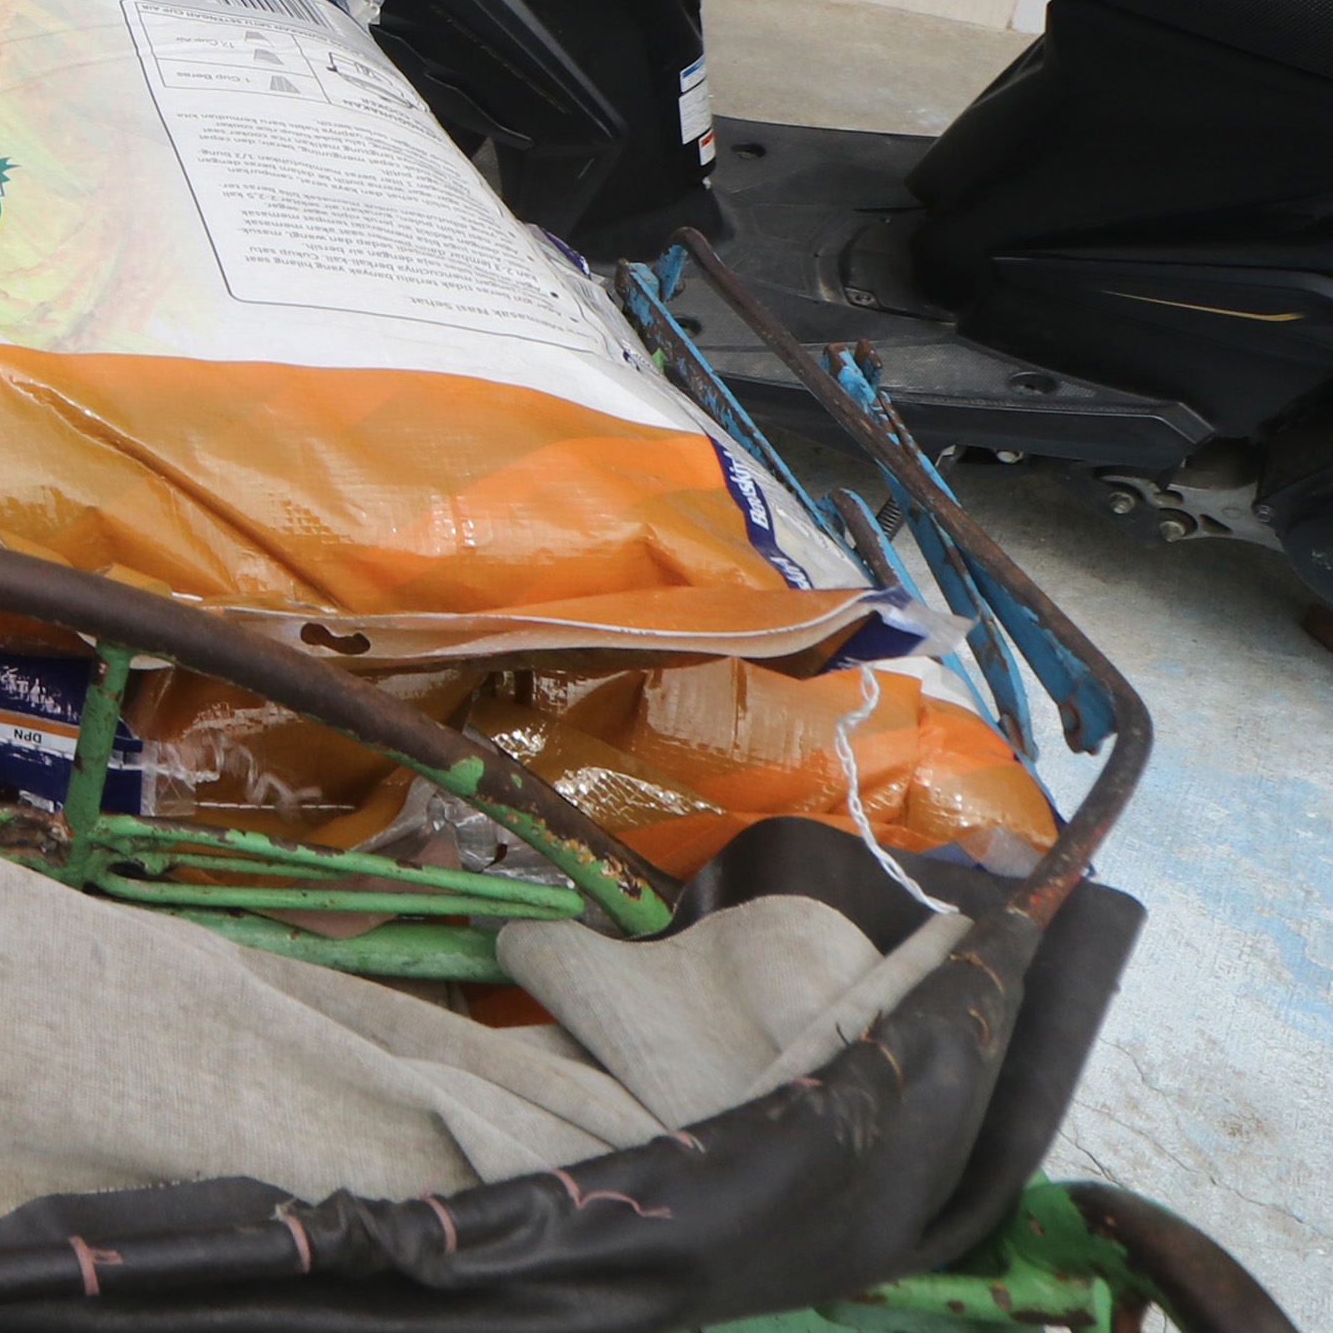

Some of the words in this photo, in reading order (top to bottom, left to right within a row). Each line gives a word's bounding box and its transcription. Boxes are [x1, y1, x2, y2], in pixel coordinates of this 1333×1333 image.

[141, 4, 159, 12] AIR
[162, 7, 183, 15] CUP
[195, 36, 219, 46] Cup
[176, 72, 217, 80] Beras
[221, 73, 241, 82] Cup
[201, 114, 257, 124] kemudian
[260, 119, 286, 128] baru
[216, 122, 254, 130] cooker
[199, 134, 231, 142] cepat
[229, 130, 268, 139] cooker
[294, 138, 340, 151] matikan
[197, 156, 241, 167] dengan
[234, 152, 255, 161] 1/2
[243, 161, 276, 171] beras
[258, 156, 342, 176] membutuhkan
[227, 168, 293, 180] campurkan
[279, 166, 314, 178] dalam
[344, 171, 377, 182] beras
[295, 176, 328, 188] serat,
[334, 177, 364, 187] putih
[243, 184, 276, 196] beras
[278, 189, 300, 199] bila
[332, 184, 358, 194] kaya
[360, 189, 383, 197] dan
[222, 191, 243, 199] kali
[281, 197, 320, 208] sekitar
[303, 194, 360, 208] memasak
[264, 202, 299, 212] segar.
[241, 210, 300, 221] memasak
[303, 215, 348, 226] tempat
[244, 219, 303, 230] memasak
[306, 225, 335, 234] akan
[339, 228, 364, 237] saat
[329, 236, 353, 245] dan
[357, 239, 393, 251] sedap
[249, 246, 276, 254] satu
[302, 243, 344, 254] bersih.
[349, 248, 364, 256] air
[244, 255, 270, 263] saat
[279, 249, 319, 260] Cukup
[367, 250, 413, 264] dengan
[273, 257, 313, 271] hilang
[417, 258, 441, 267] saja
[450, 254, 492, 269] lembar
[315, 262, 345, 272] yang
[495, 264, 512, 275] 2-3
[349, 268, 393, 281] banyak
[398, 266, 472, 284] mencucinya
[396, 275, 438, 287] terlalu
[409, 296, 453, 311] Sehat
[456, 305, 489, 317] Nasi
